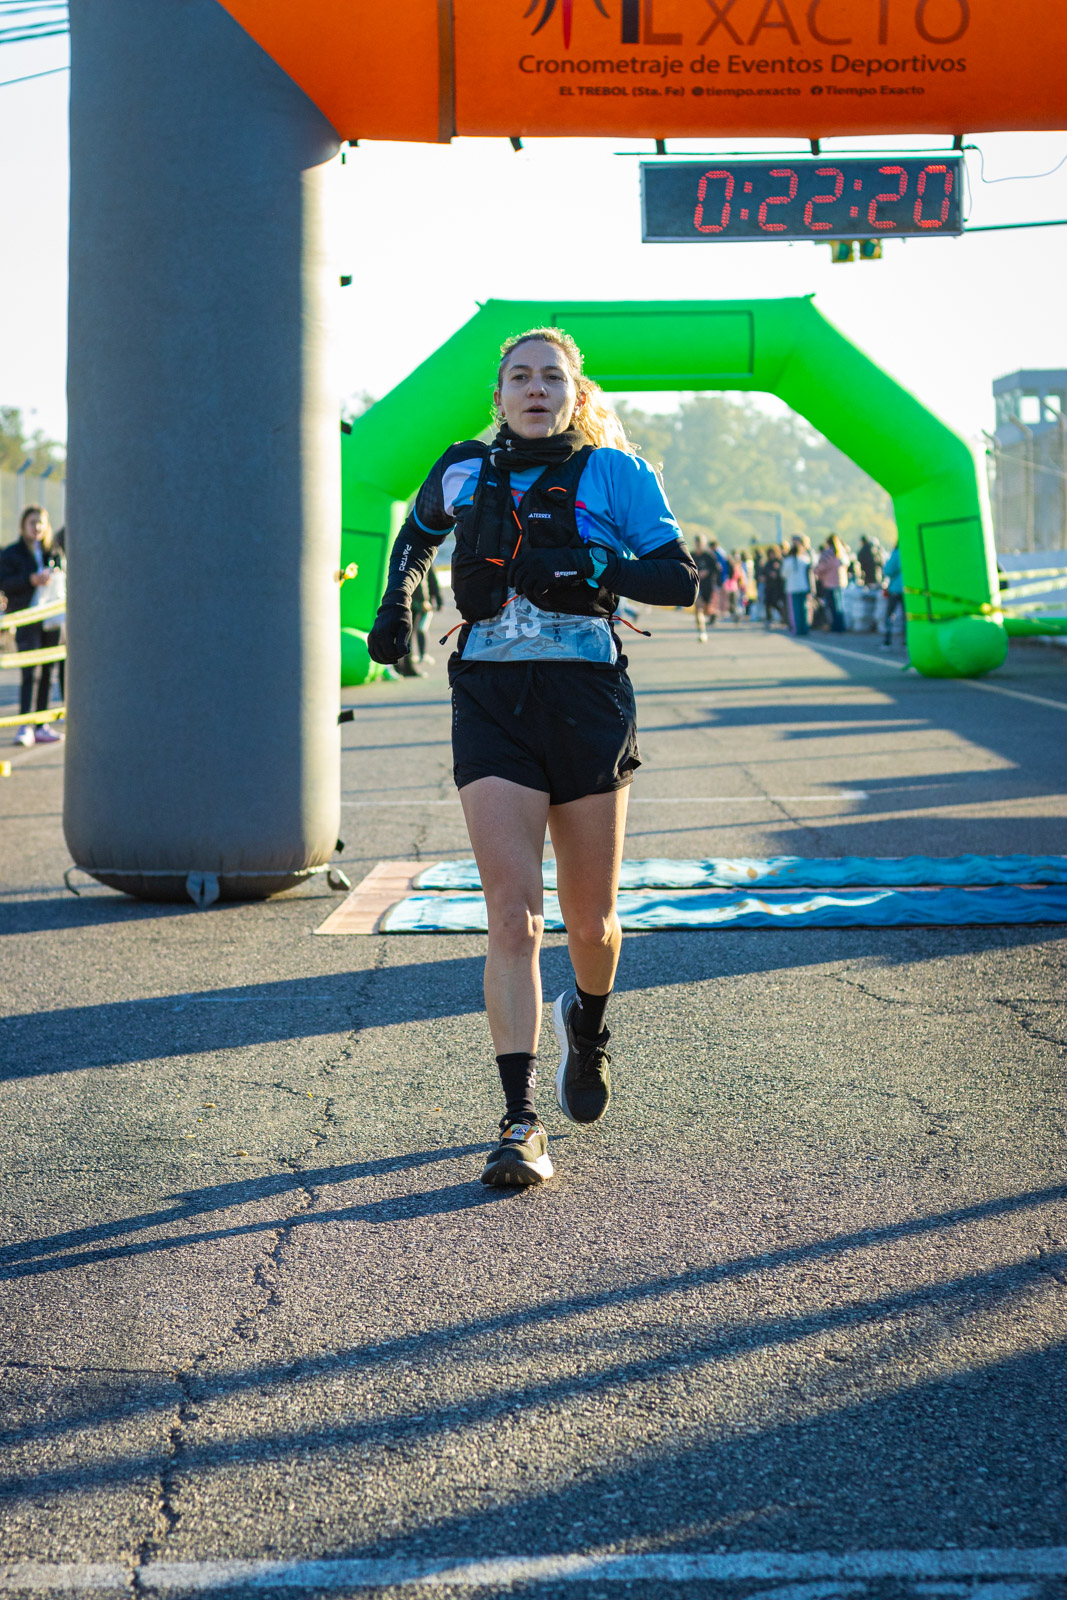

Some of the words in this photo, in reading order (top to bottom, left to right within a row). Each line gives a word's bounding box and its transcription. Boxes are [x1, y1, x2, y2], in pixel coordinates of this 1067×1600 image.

[518, 54, 684, 78] Cronometraje
[690, 54, 720, 73] de
[727, 54, 823, 73] Eventos
[831, 54, 967, 77] Deportivos
[559, 86, 575, 96] EL
[578, 86, 629, 96] TREBOL
[665, 86, 686, 97] Fe)
[826, 85, 877, 97] Tiempo
[880, 85, 925, 95] Exacto
[694, 164, 953, 233] 0:22:20
[501, 598, 541, 638] 43
